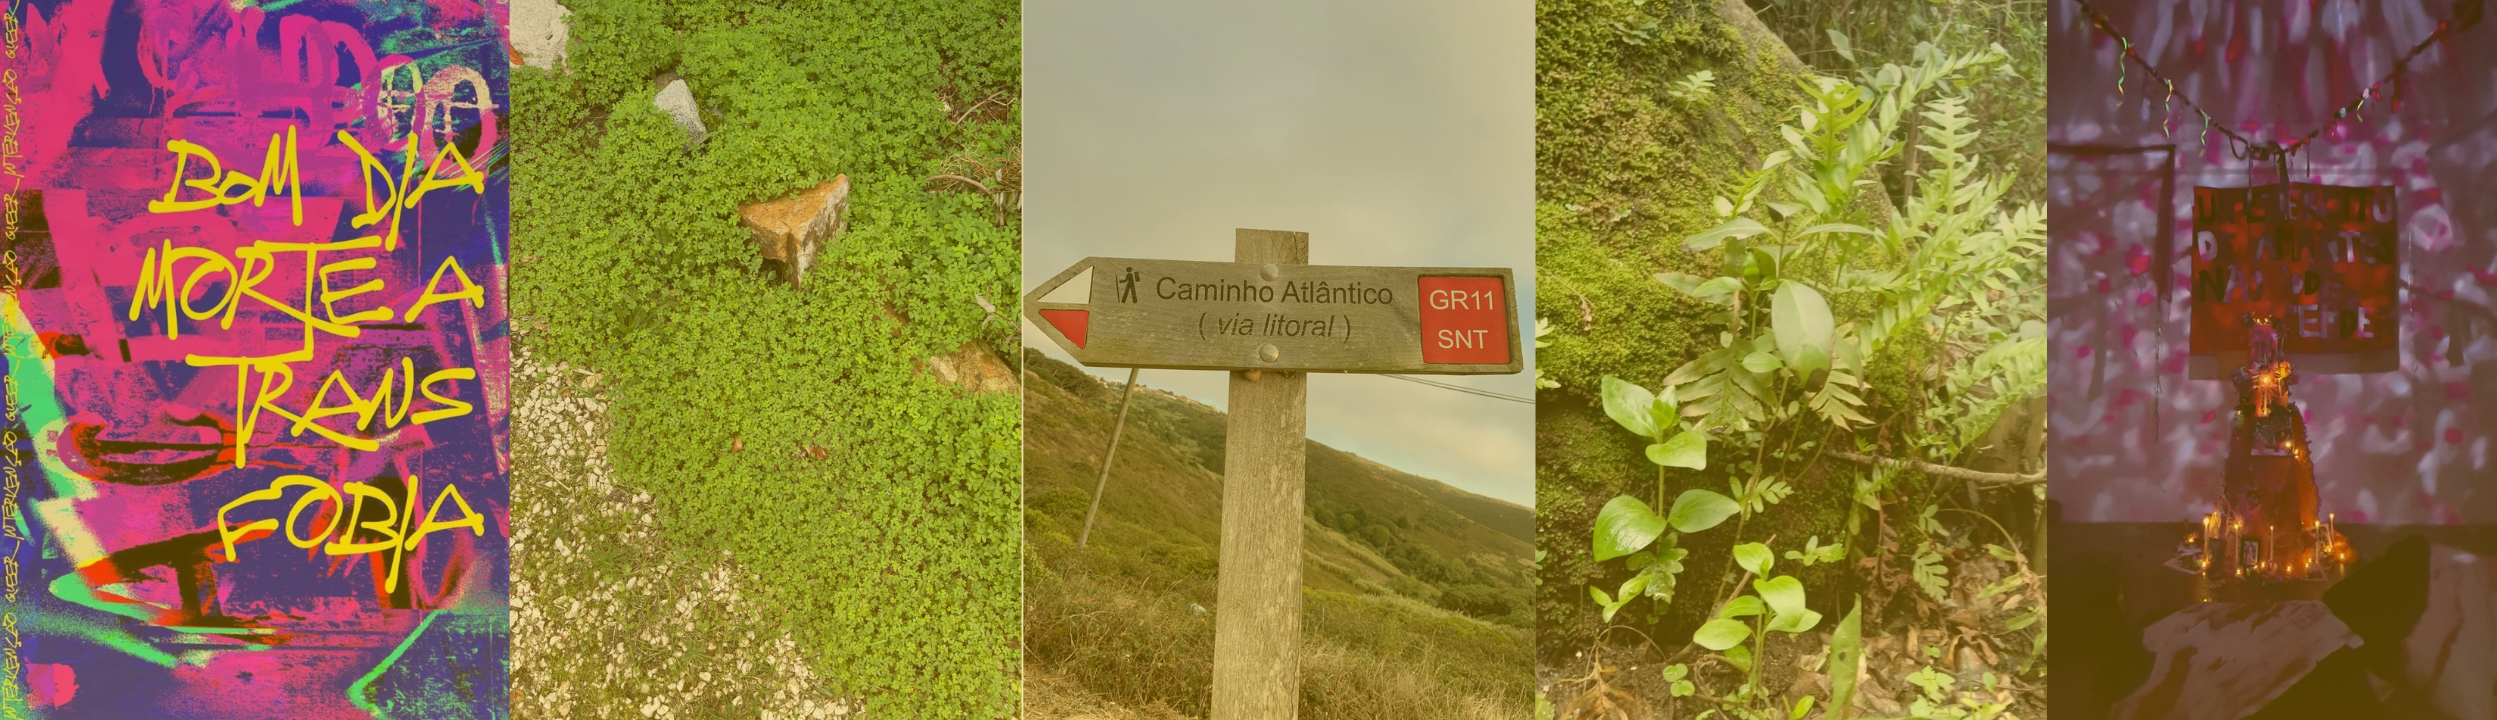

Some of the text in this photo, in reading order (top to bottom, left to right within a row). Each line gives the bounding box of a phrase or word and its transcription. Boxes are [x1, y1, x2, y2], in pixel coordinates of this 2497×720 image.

[337, 129, 485, 251] DIA
[129, 236, 484, 359] MORTE A
[1155, 275, 1394, 306] Caminho Atlântico
[1217, 313, 1255, 337] via
[1262, 312, 1336, 339] litoral
[1428, 289, 1495, 312] GR11
[1436, 328, 1489, 351] SNT
[185, 354, 476, 469] TRANS
[218, 474, 484, 594] FOBIA
